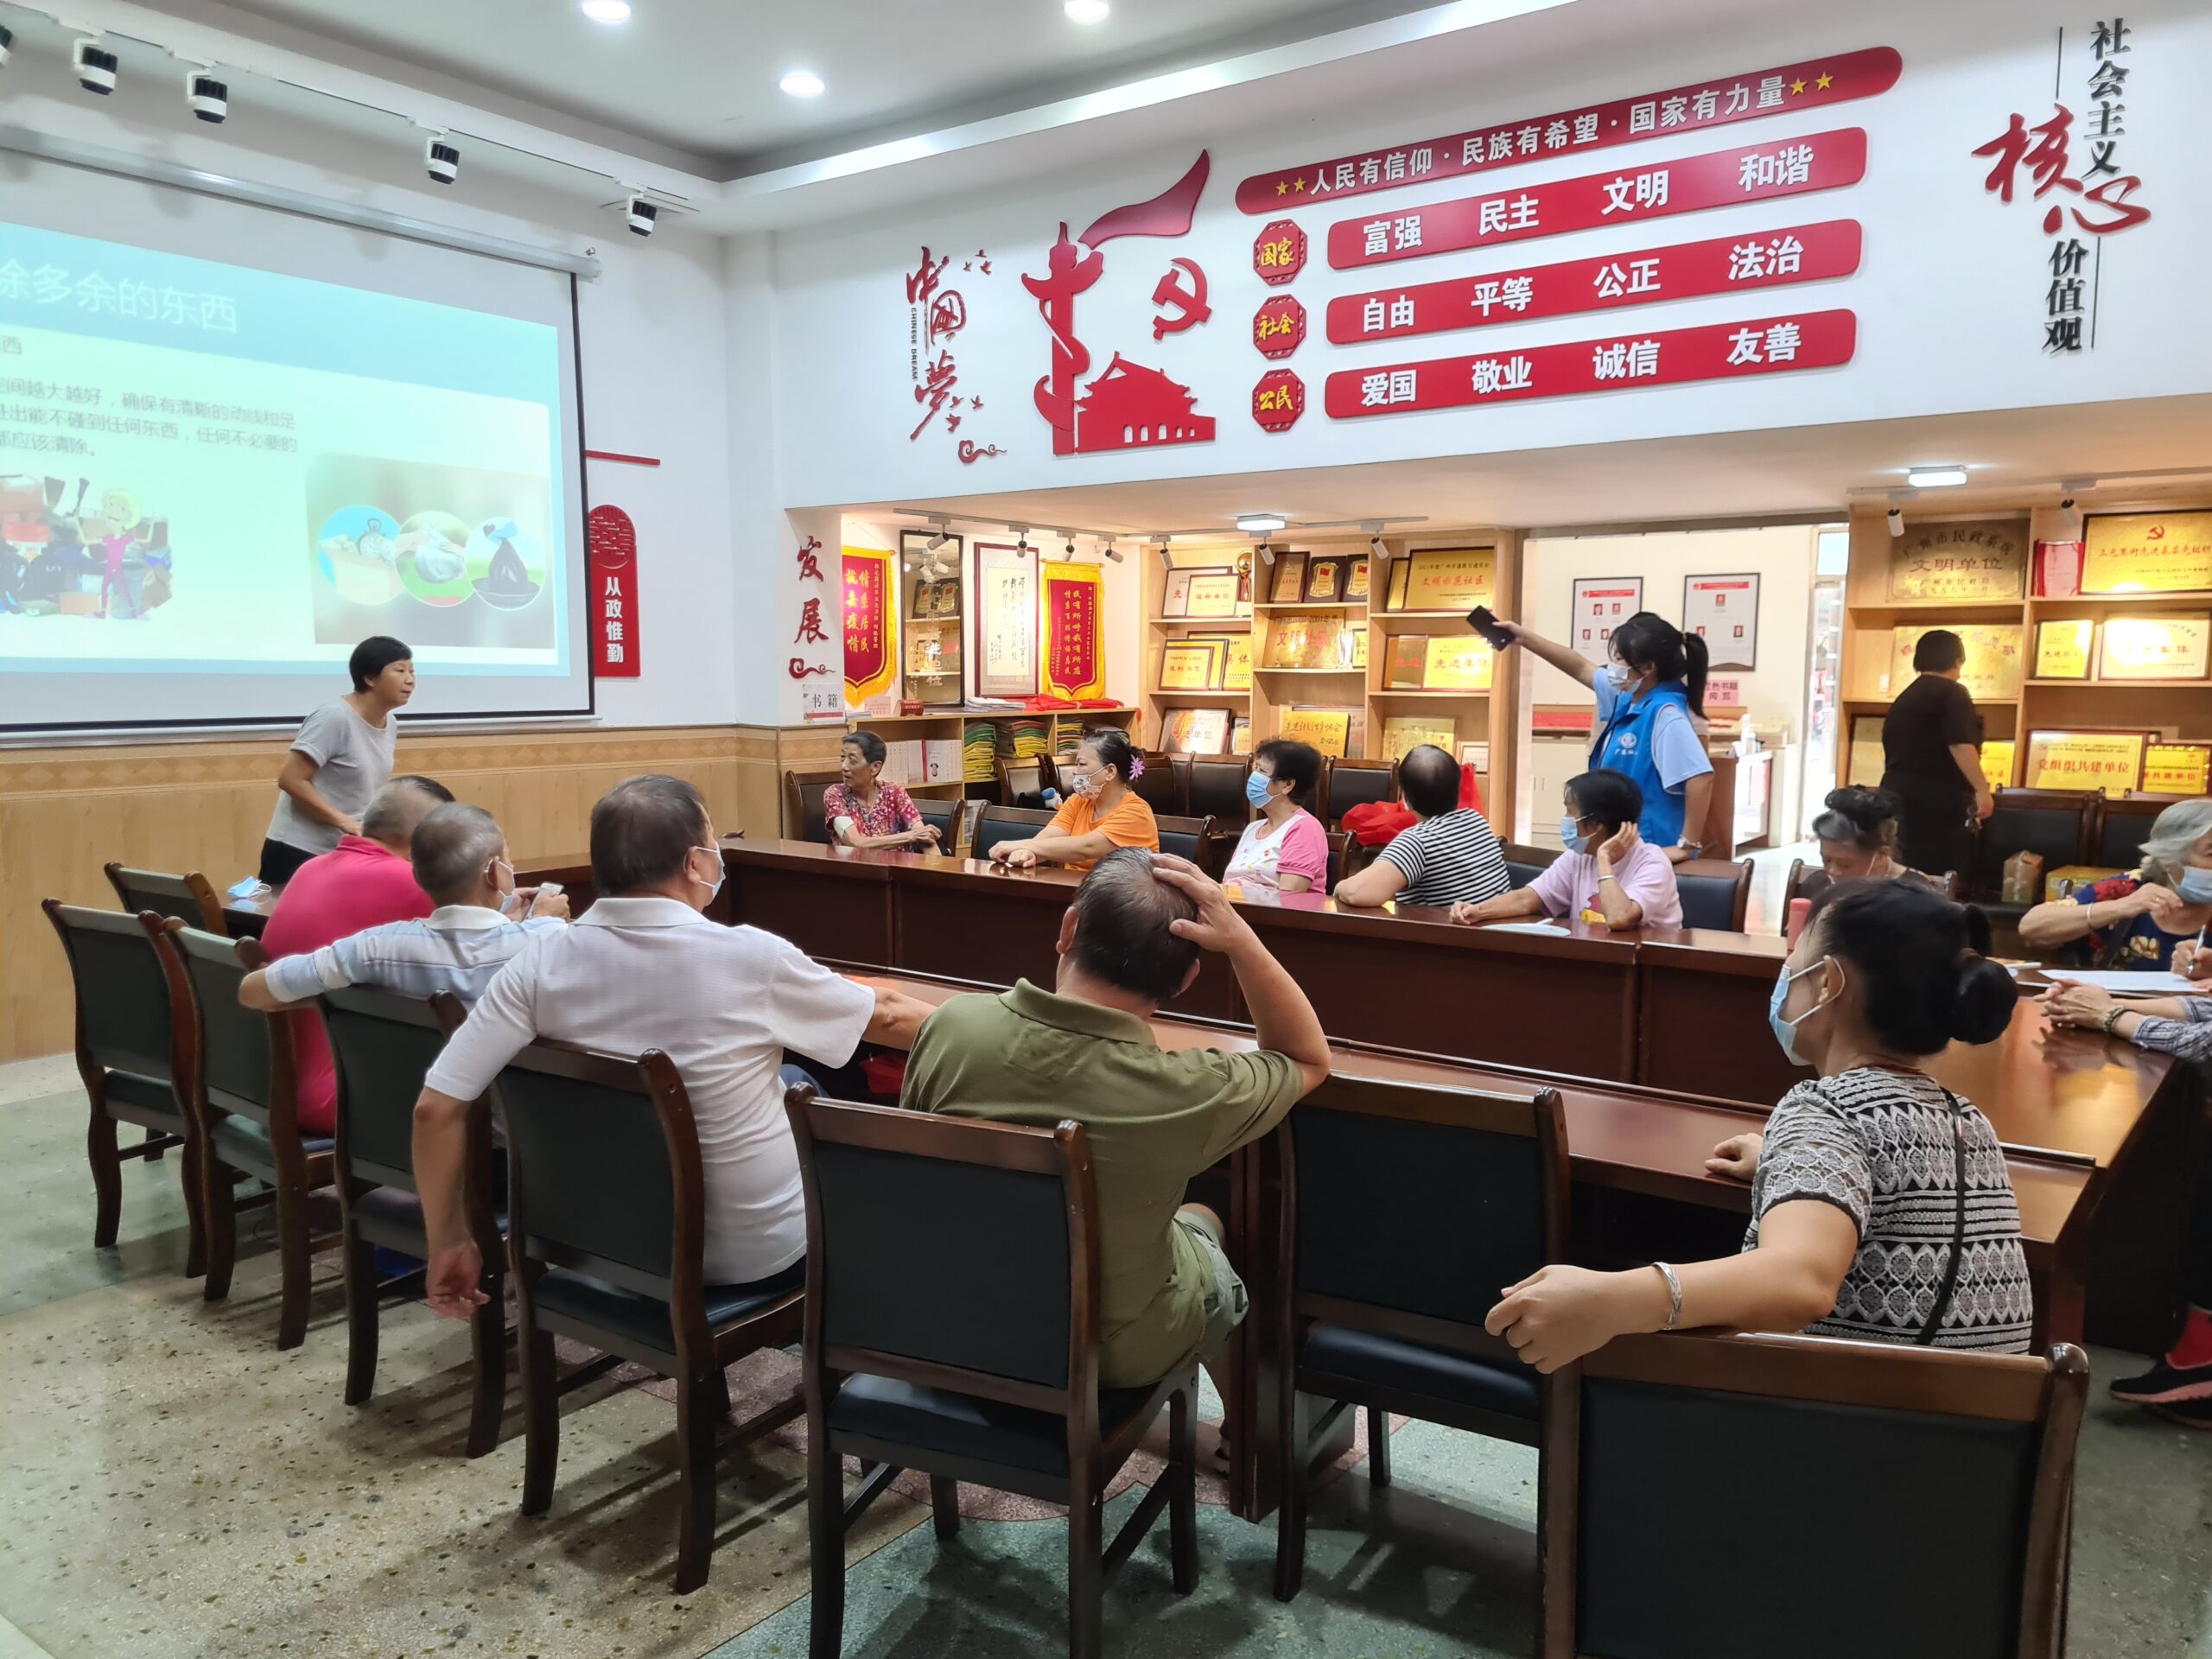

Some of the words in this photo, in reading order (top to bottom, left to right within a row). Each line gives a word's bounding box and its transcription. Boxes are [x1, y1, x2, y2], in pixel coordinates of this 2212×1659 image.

[2082, 17, 2132, 179] 社会主义
[1363, 216, 1422, 254] 富强
[1478, 196, 1539, 235] 民主
[1602, 170, 1669, 213] 文明
[1738, 145, 1814, 191] 和谐
[1971, 103, 2152, 235] 核心
[1261, 238, 1294, 267] 国家
[1363, 295, 1415, 332] 自由
[1471, 276, 1534, 316] 平等
[1593, 259, 1661, 299] 公正
[1729, 238, 1803, 279] 法治
[2042, 238, 2088, 353] 价值观
[1259, 312, 1295, 340] 社会
[1361, 369, 1417, 406] 爱国
[1471, 356, 1532, 394] 敬业
[1592, 340, 1661, 379] 诚信
[1726, 324, 1801, 365] 友善
[1259, 385, 1294, 410] 公民
[794, 536, 830, 645] 发展
[1910, 557, 2003, 572] 文明单位
[605, 576, 624, 664] 从政惟勤
[811, 694, 838, 708] 书籍
